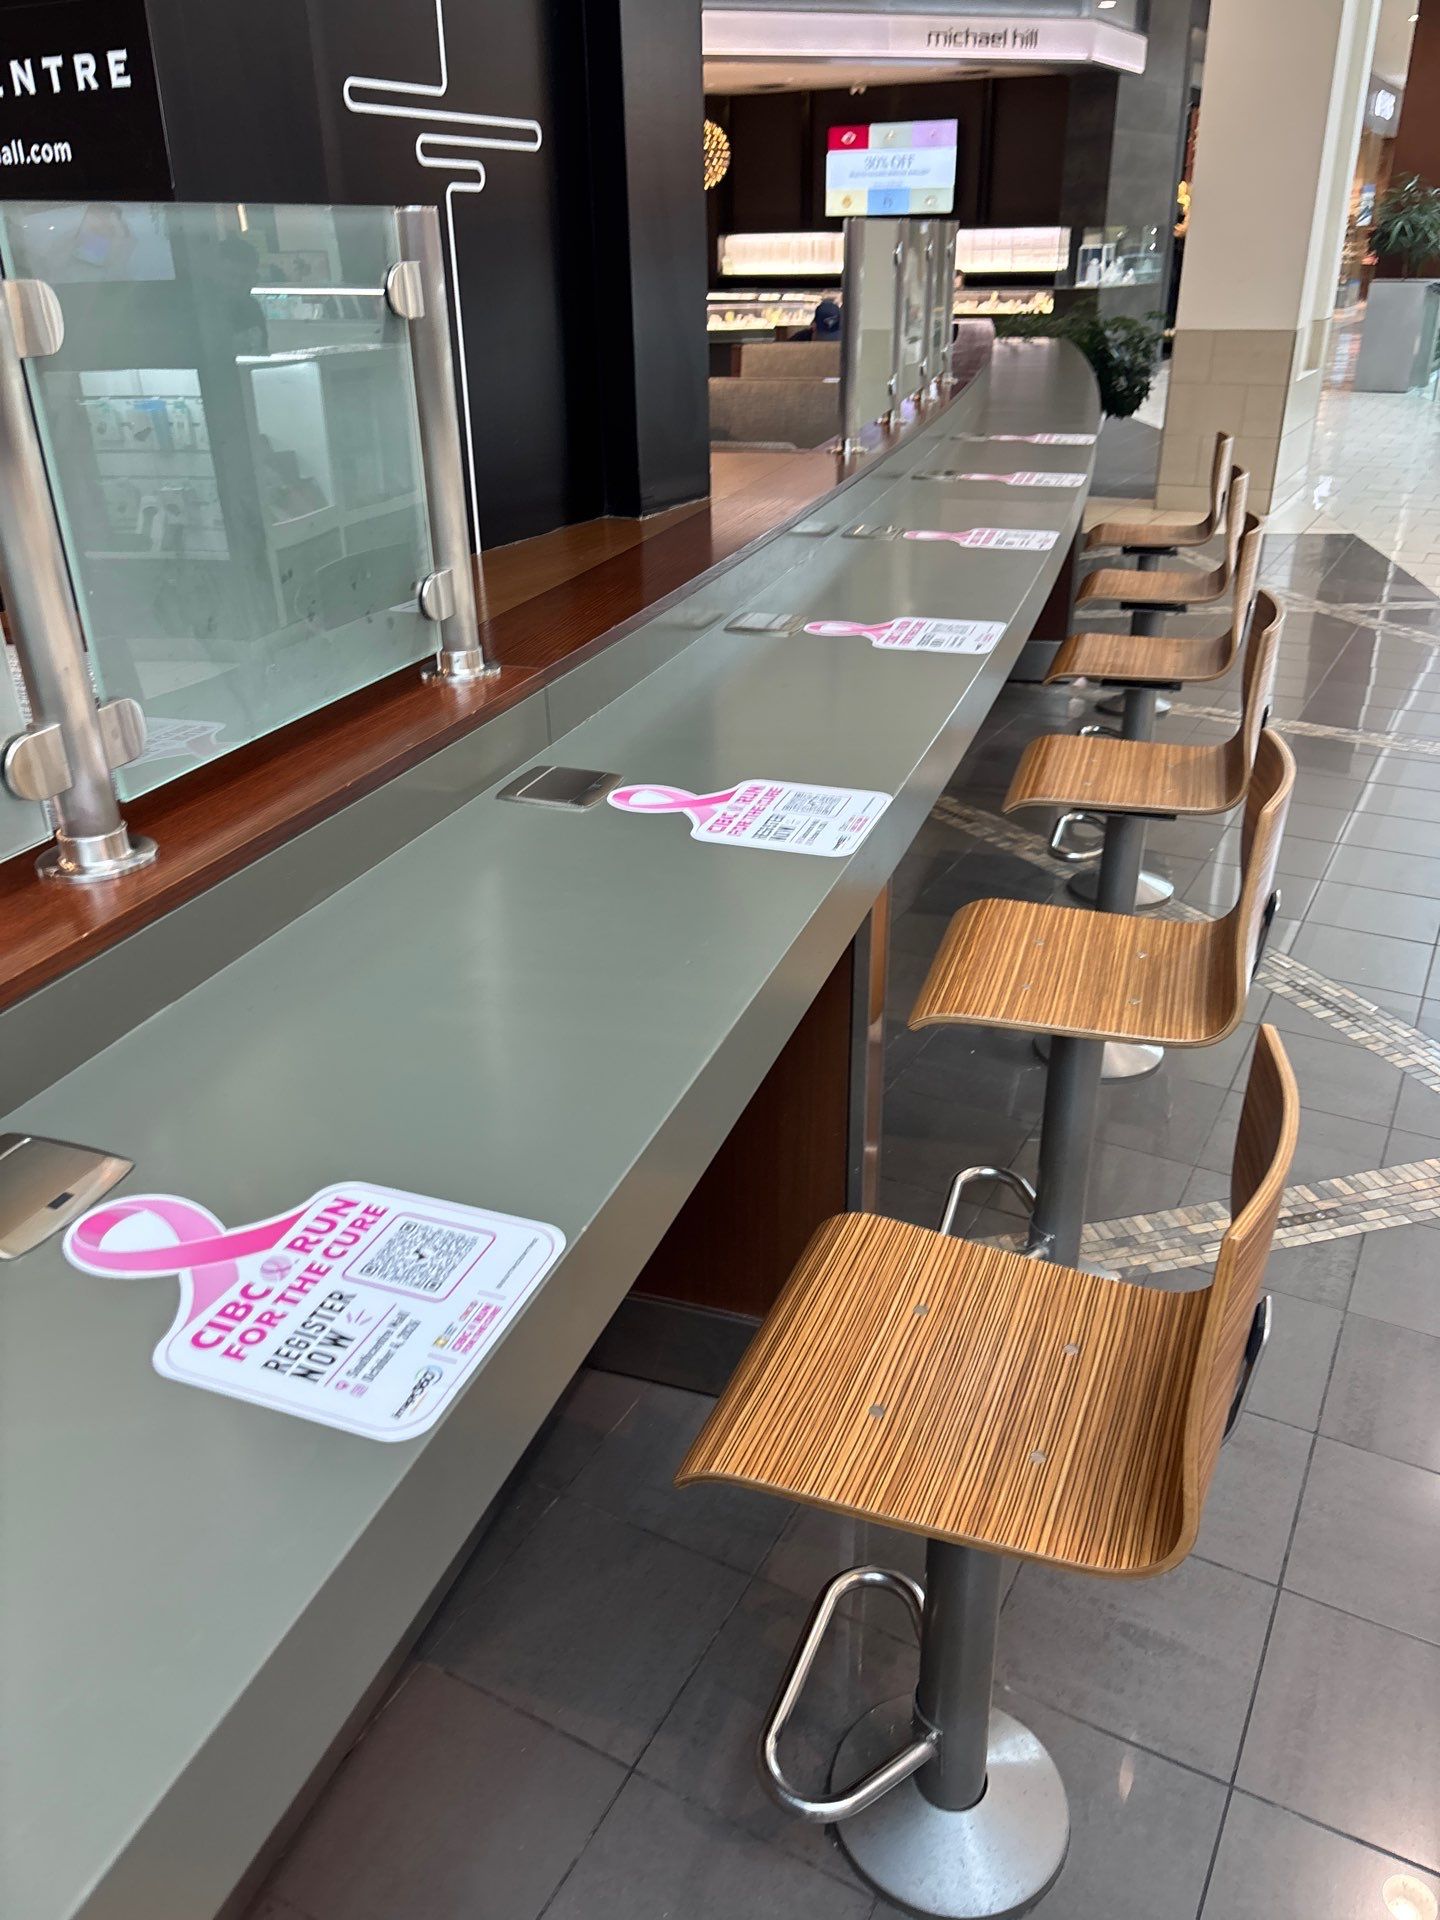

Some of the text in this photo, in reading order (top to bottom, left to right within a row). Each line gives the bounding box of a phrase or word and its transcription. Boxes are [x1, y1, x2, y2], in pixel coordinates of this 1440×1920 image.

[926, 27, 1039, 49] michael hill
[0, 48, 132, 98] NTRE
[0, 138, 73, 165] all.com
[190, 1197, 361, 1349] CIBC RUN
[220, 1202, 390, 1363] FOR THE CURE
[261, 1289, 358, 1376] REGISTER
[290, 1327, 357, 1385] NOW
